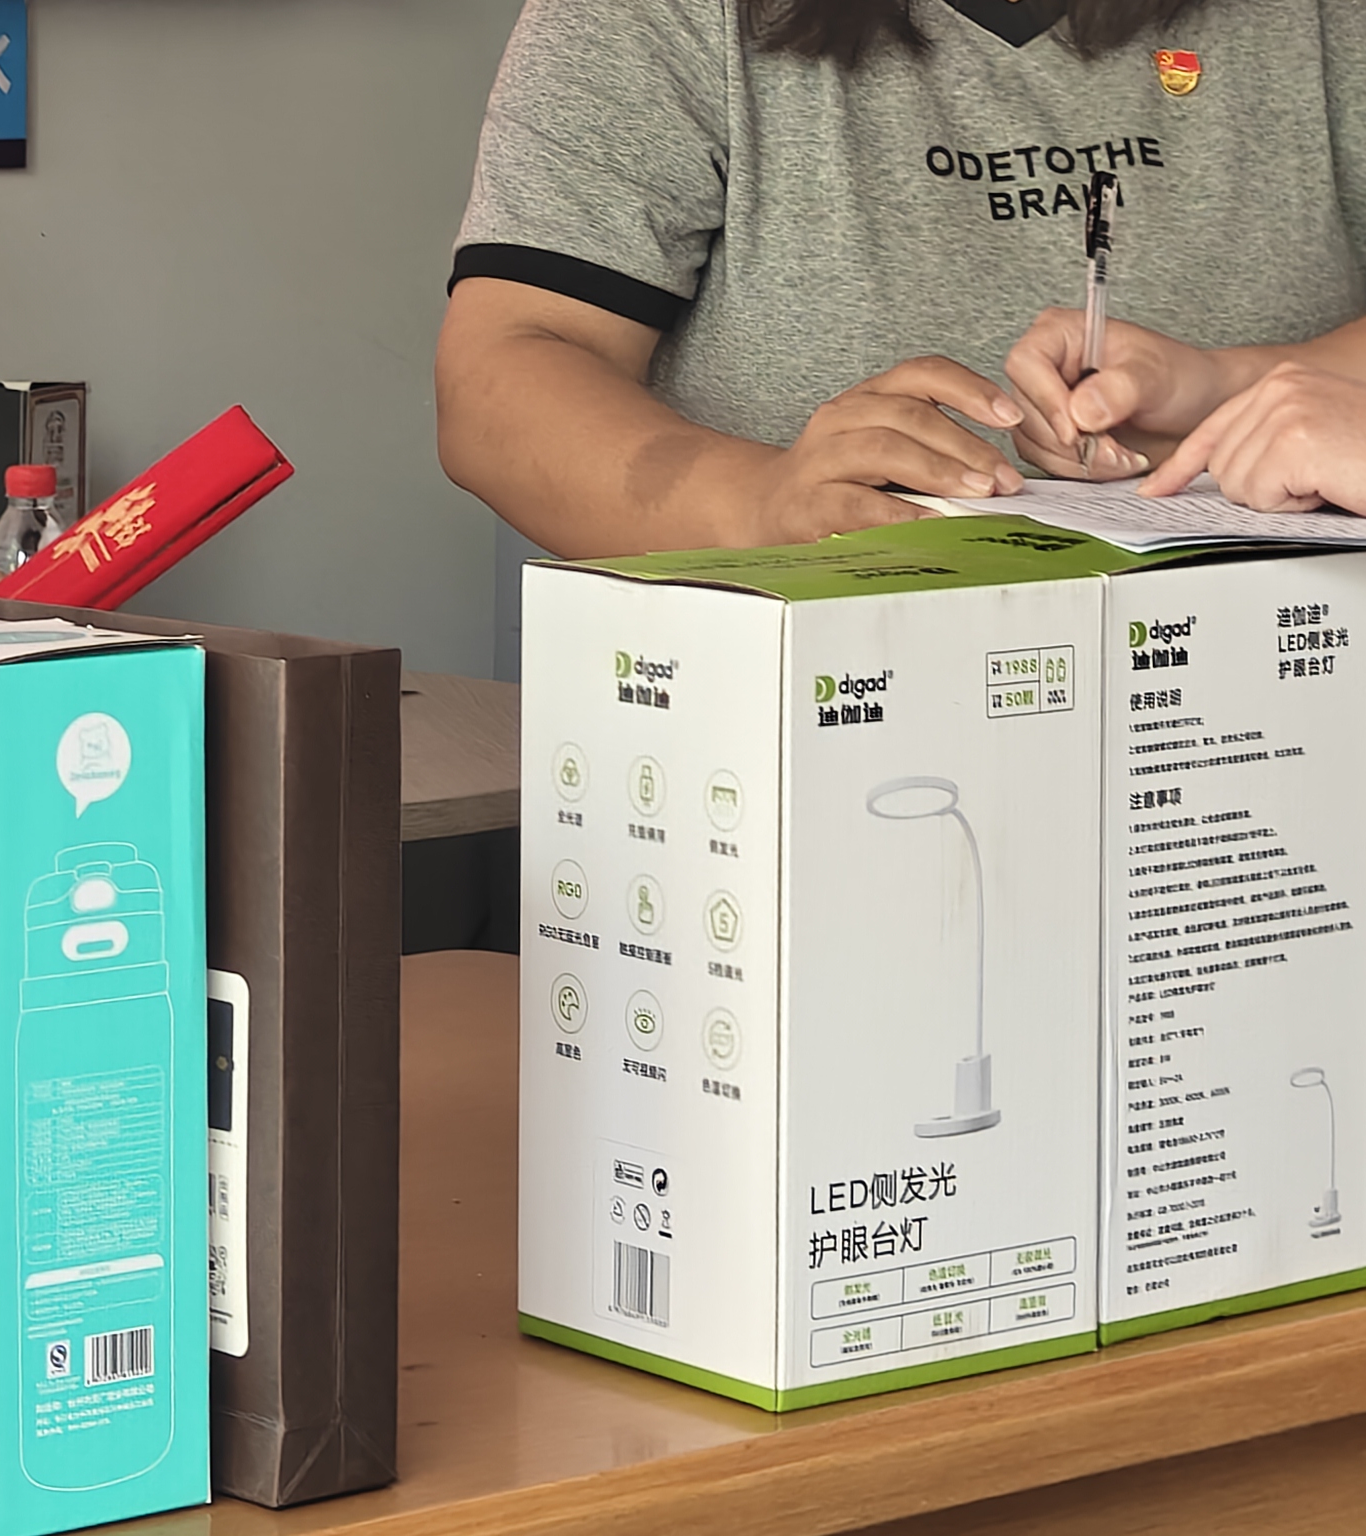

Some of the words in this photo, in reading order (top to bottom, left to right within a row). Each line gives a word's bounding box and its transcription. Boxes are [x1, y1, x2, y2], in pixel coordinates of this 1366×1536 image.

[925, 136, 1165, 183] ODETOTHE
[817, 702, 884, 727] 迪伽迪
[1129, 787, 1183, 811] 注意事项
[810, 1161, 958, 1215] LED侧发光
[808, 1216, 929, 1269] 护眼台灯
